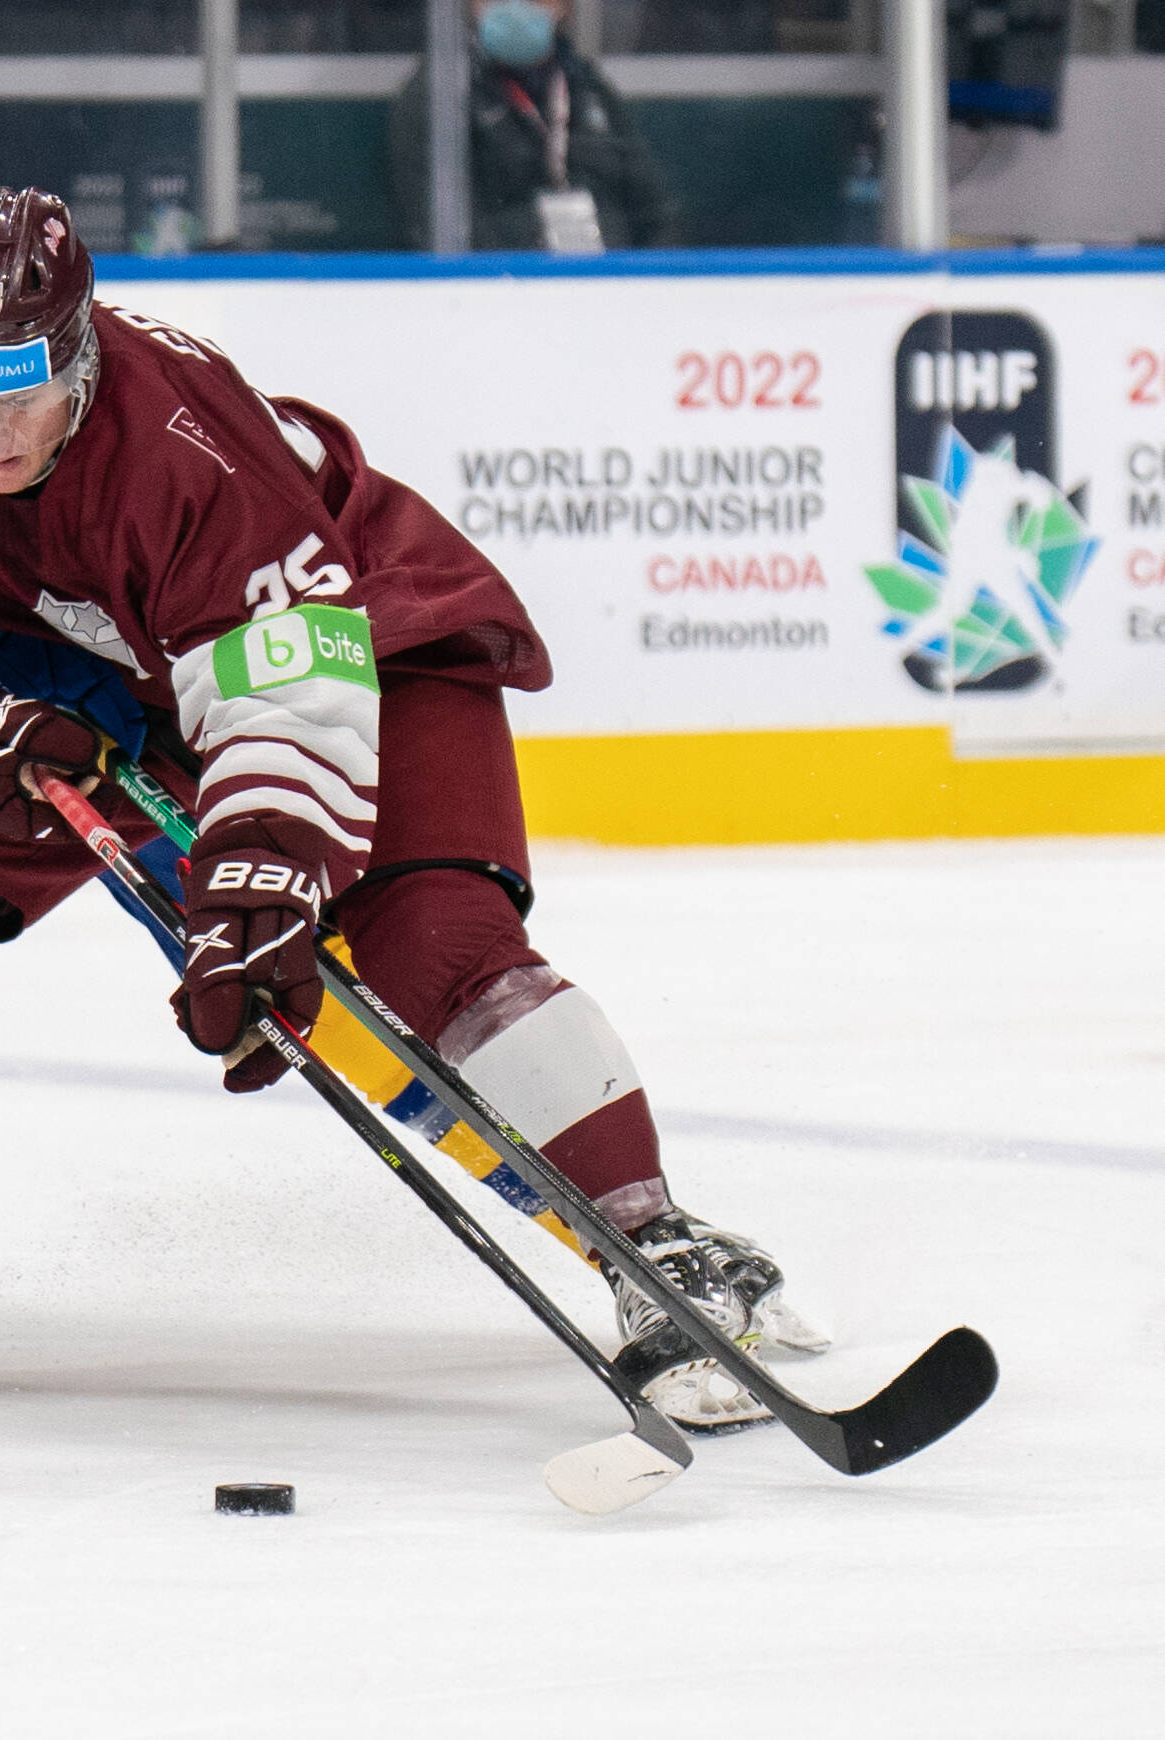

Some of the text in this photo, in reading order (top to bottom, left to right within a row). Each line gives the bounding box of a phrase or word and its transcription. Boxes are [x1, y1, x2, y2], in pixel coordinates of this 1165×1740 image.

[675, 351, 822, 408] 2022
[911, 349, 1037, 411] IIHF
[459, 447, 824, 490] WORLD JUNIOR
[459, 494, 824, 538] CHAMPIONSHIP
[245, 532, 353, 621] 25
[646, 554, 828, 594] CANADA
[315, 625, 366, 666] bite
[640, 612, 830, 652] Edmonton
